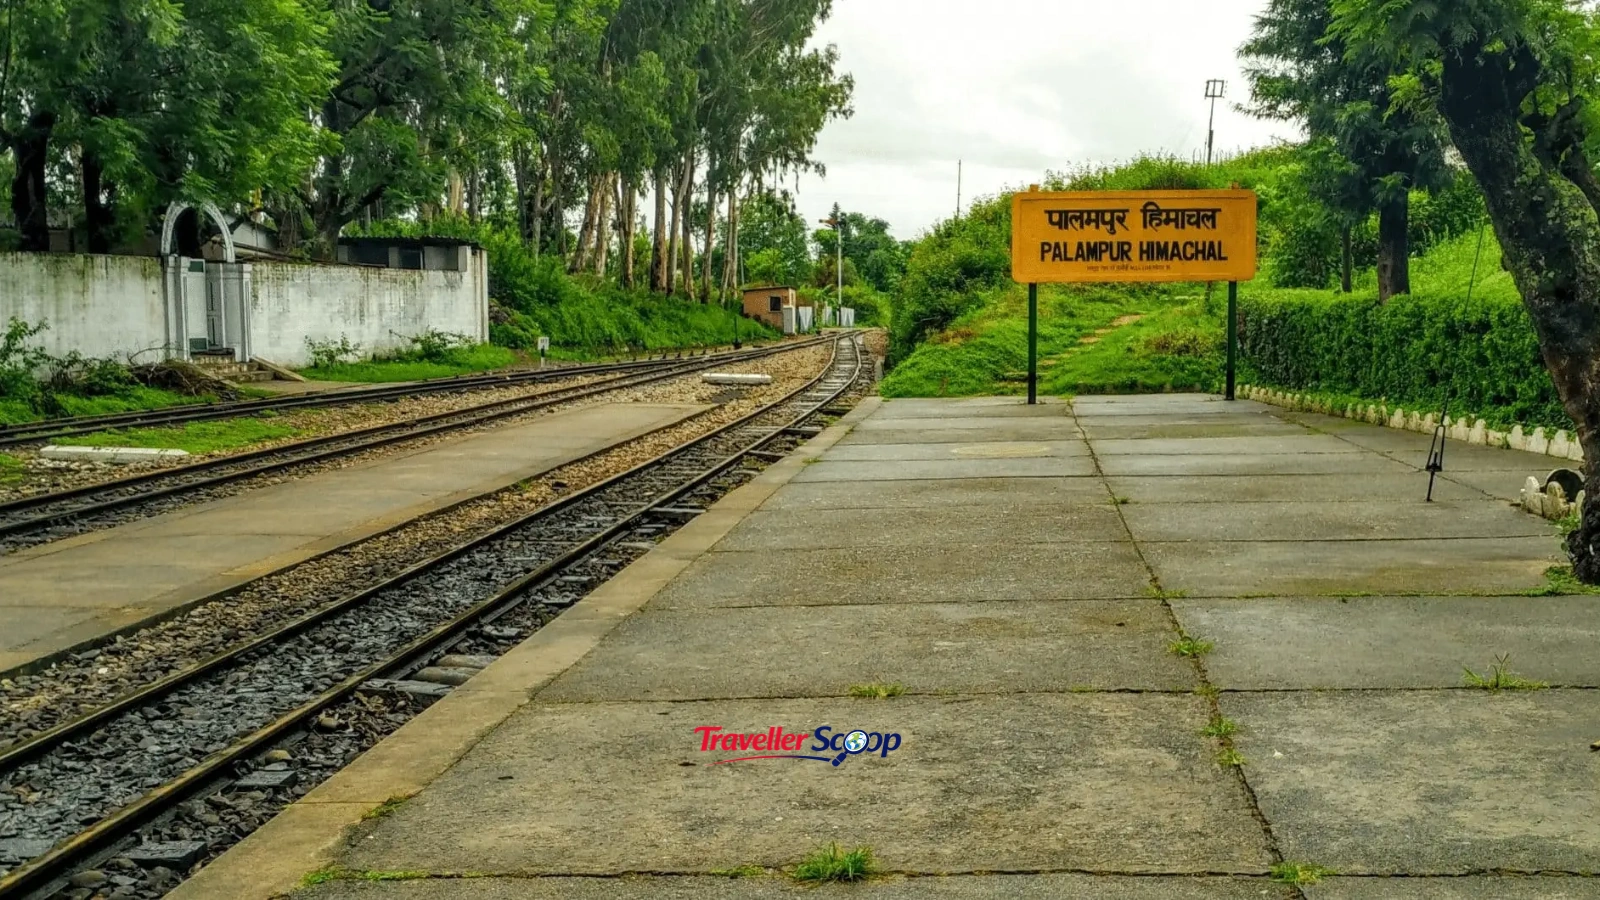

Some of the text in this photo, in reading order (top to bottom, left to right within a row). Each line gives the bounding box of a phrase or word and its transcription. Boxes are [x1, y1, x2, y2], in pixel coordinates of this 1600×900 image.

[1044, 201, 1222, 234] पालमपुर हिमाचल
[1040, 241, 1228, 262] PALAMPUR HIMACHAL
